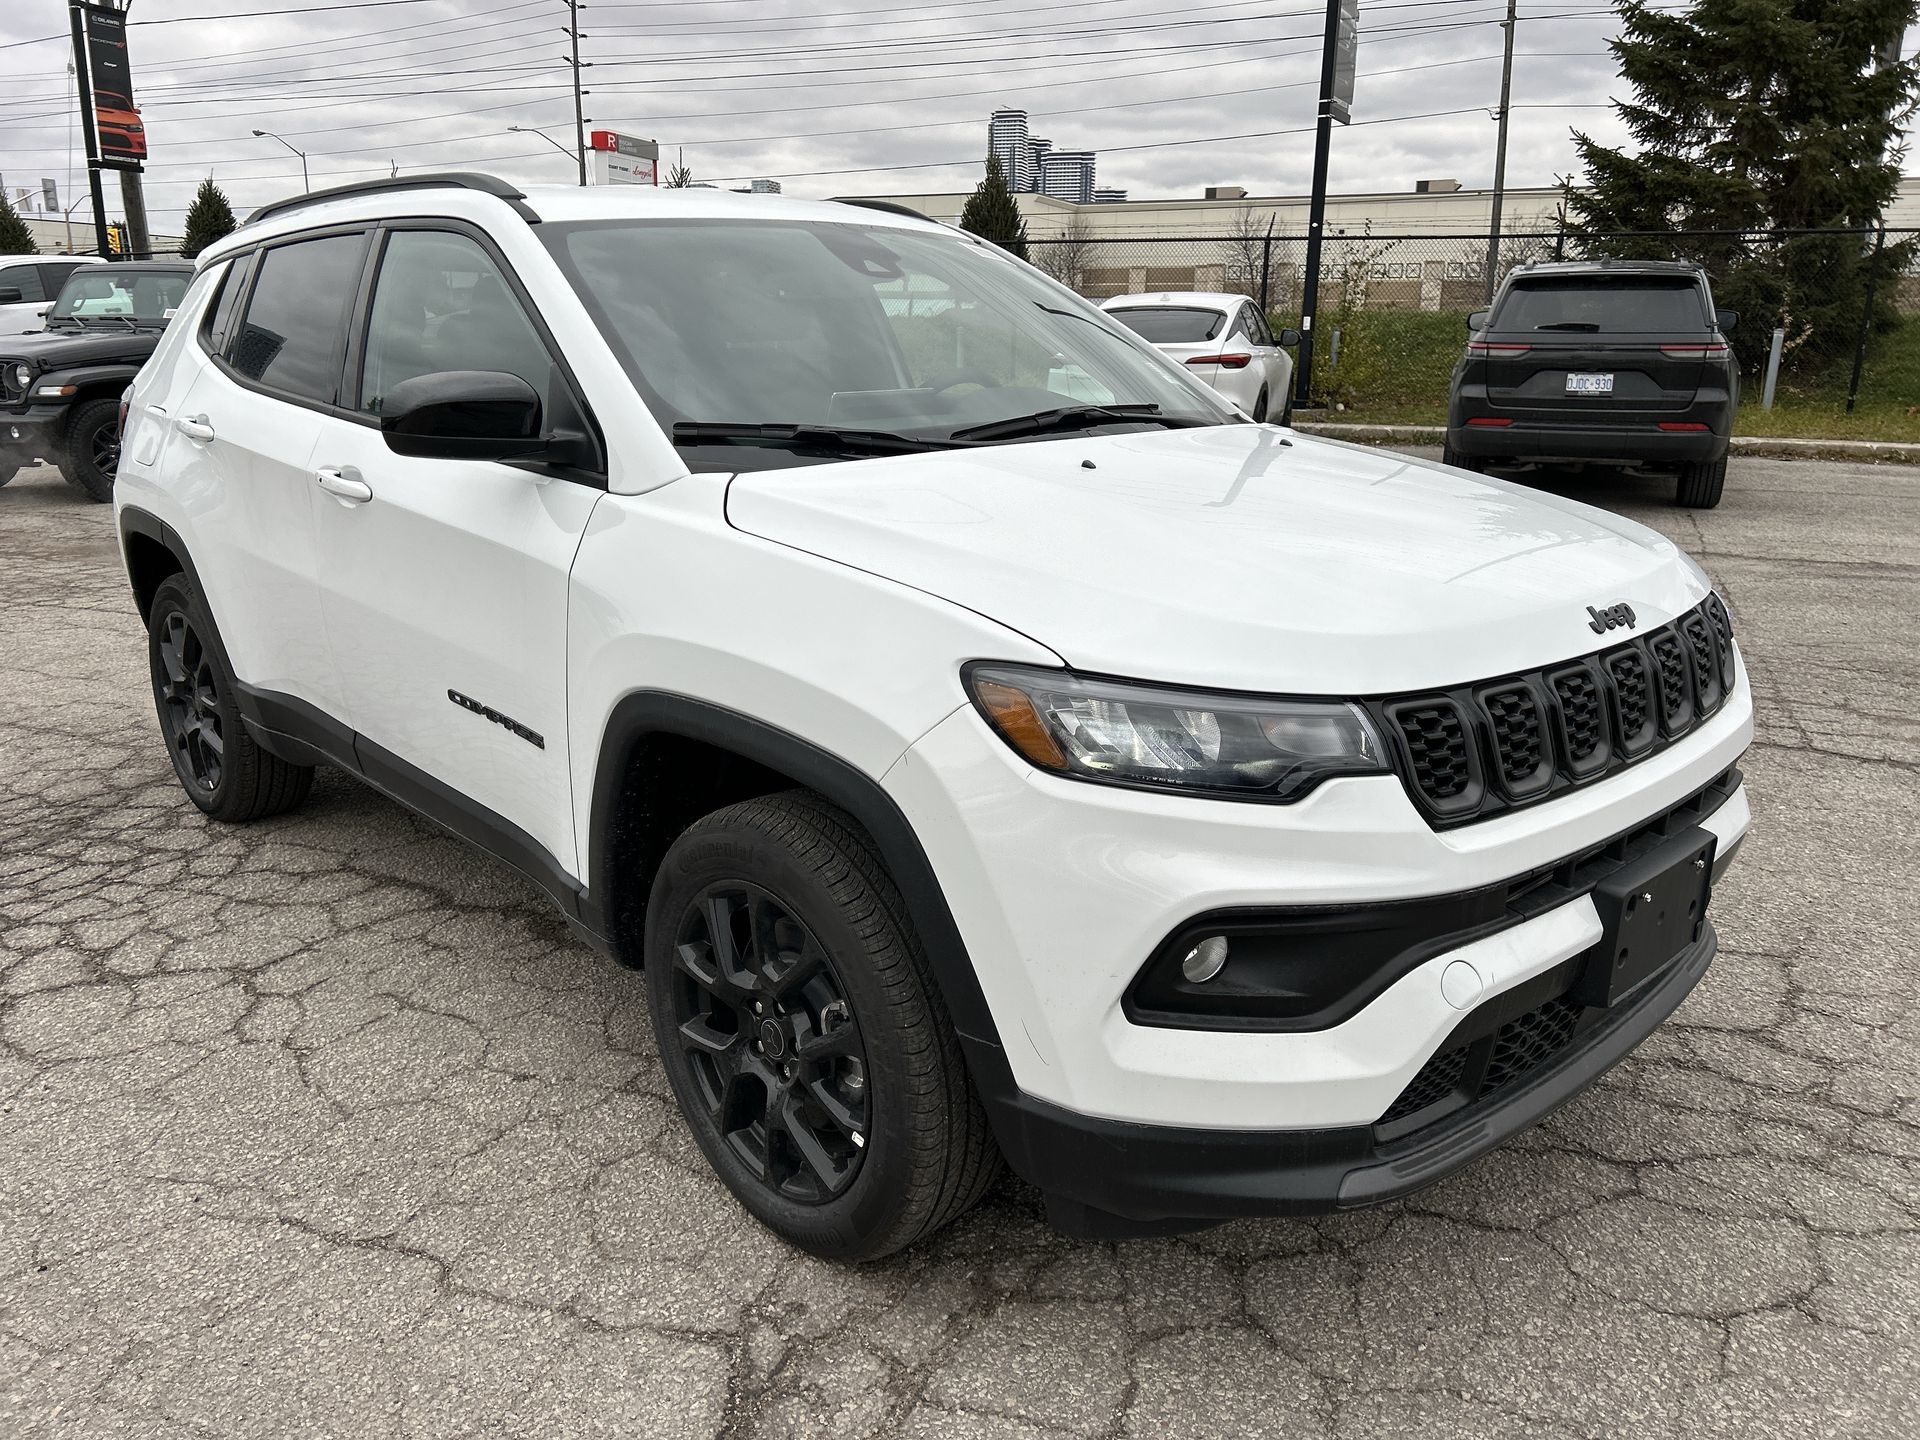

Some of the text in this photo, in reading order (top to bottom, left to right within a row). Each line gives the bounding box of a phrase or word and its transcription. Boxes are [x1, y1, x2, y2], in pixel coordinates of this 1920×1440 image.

[607, 134, 616, 148] R
[1595, 378, 1612, 390] 930
[1586, 602, 1636, 635] Jeep
[447, 688, 545, 750] COMPASS
